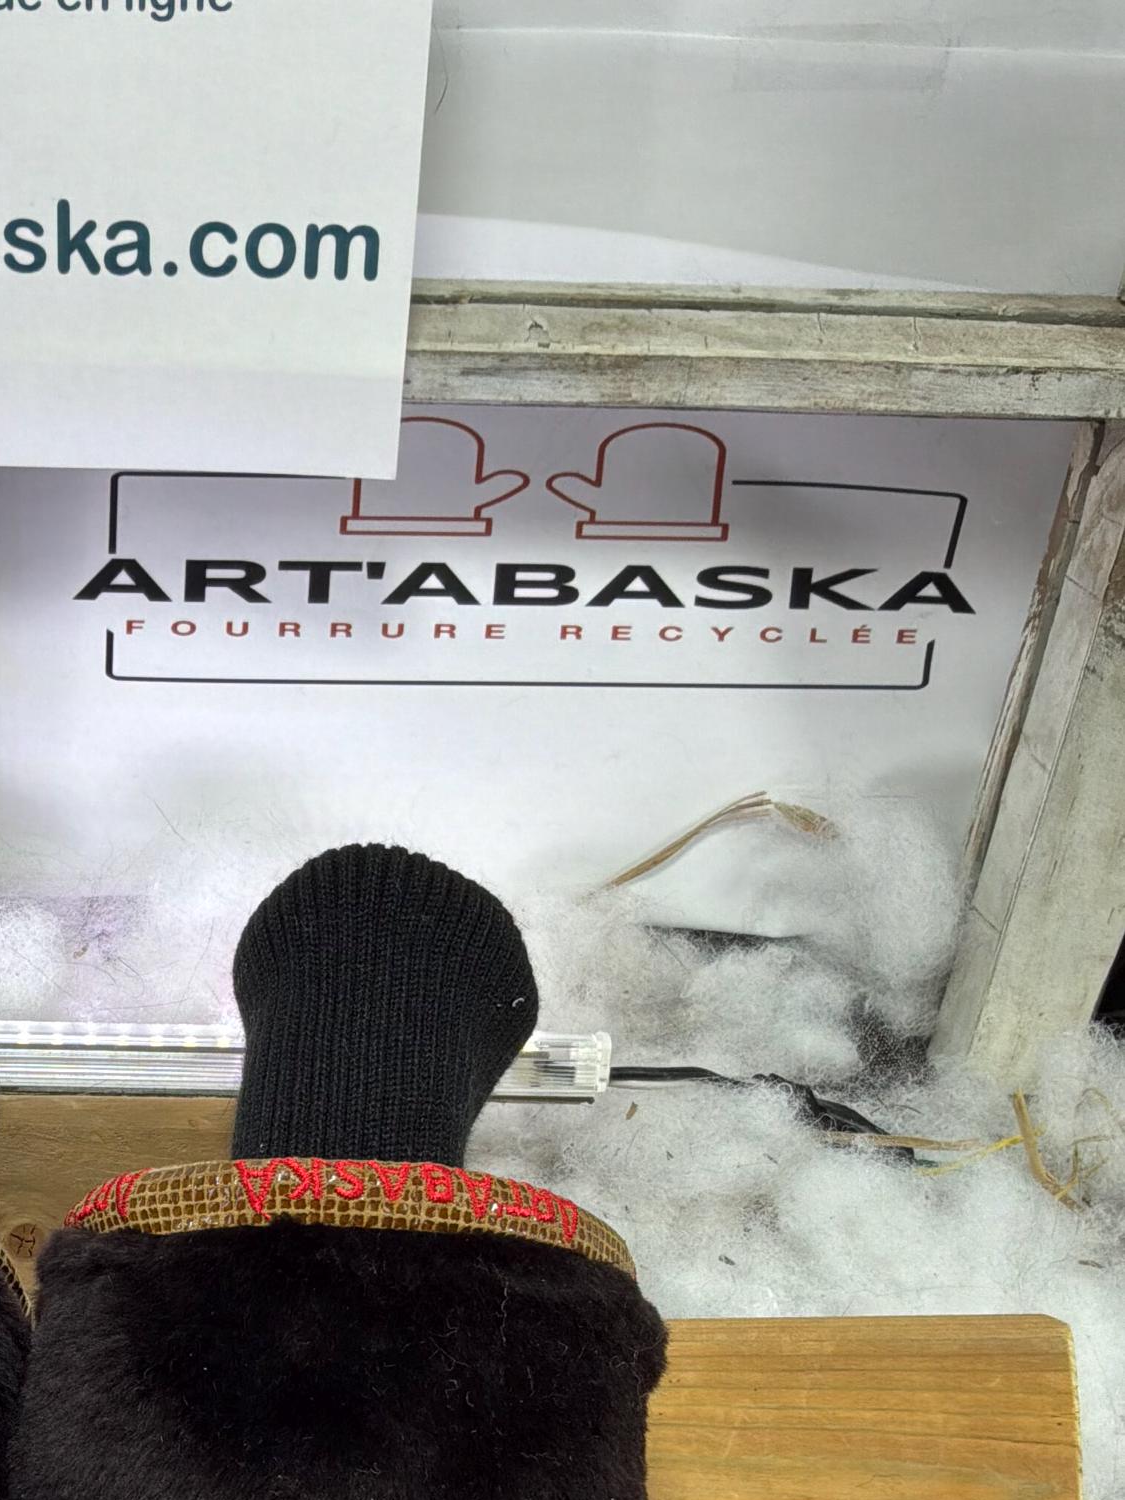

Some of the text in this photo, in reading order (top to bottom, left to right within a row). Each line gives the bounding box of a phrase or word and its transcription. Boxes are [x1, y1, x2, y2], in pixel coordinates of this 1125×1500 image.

[74, 558, 976, 615] ART'ABASKA
[125, 619, 920, 646] FOURRURE RECYCLÉE
